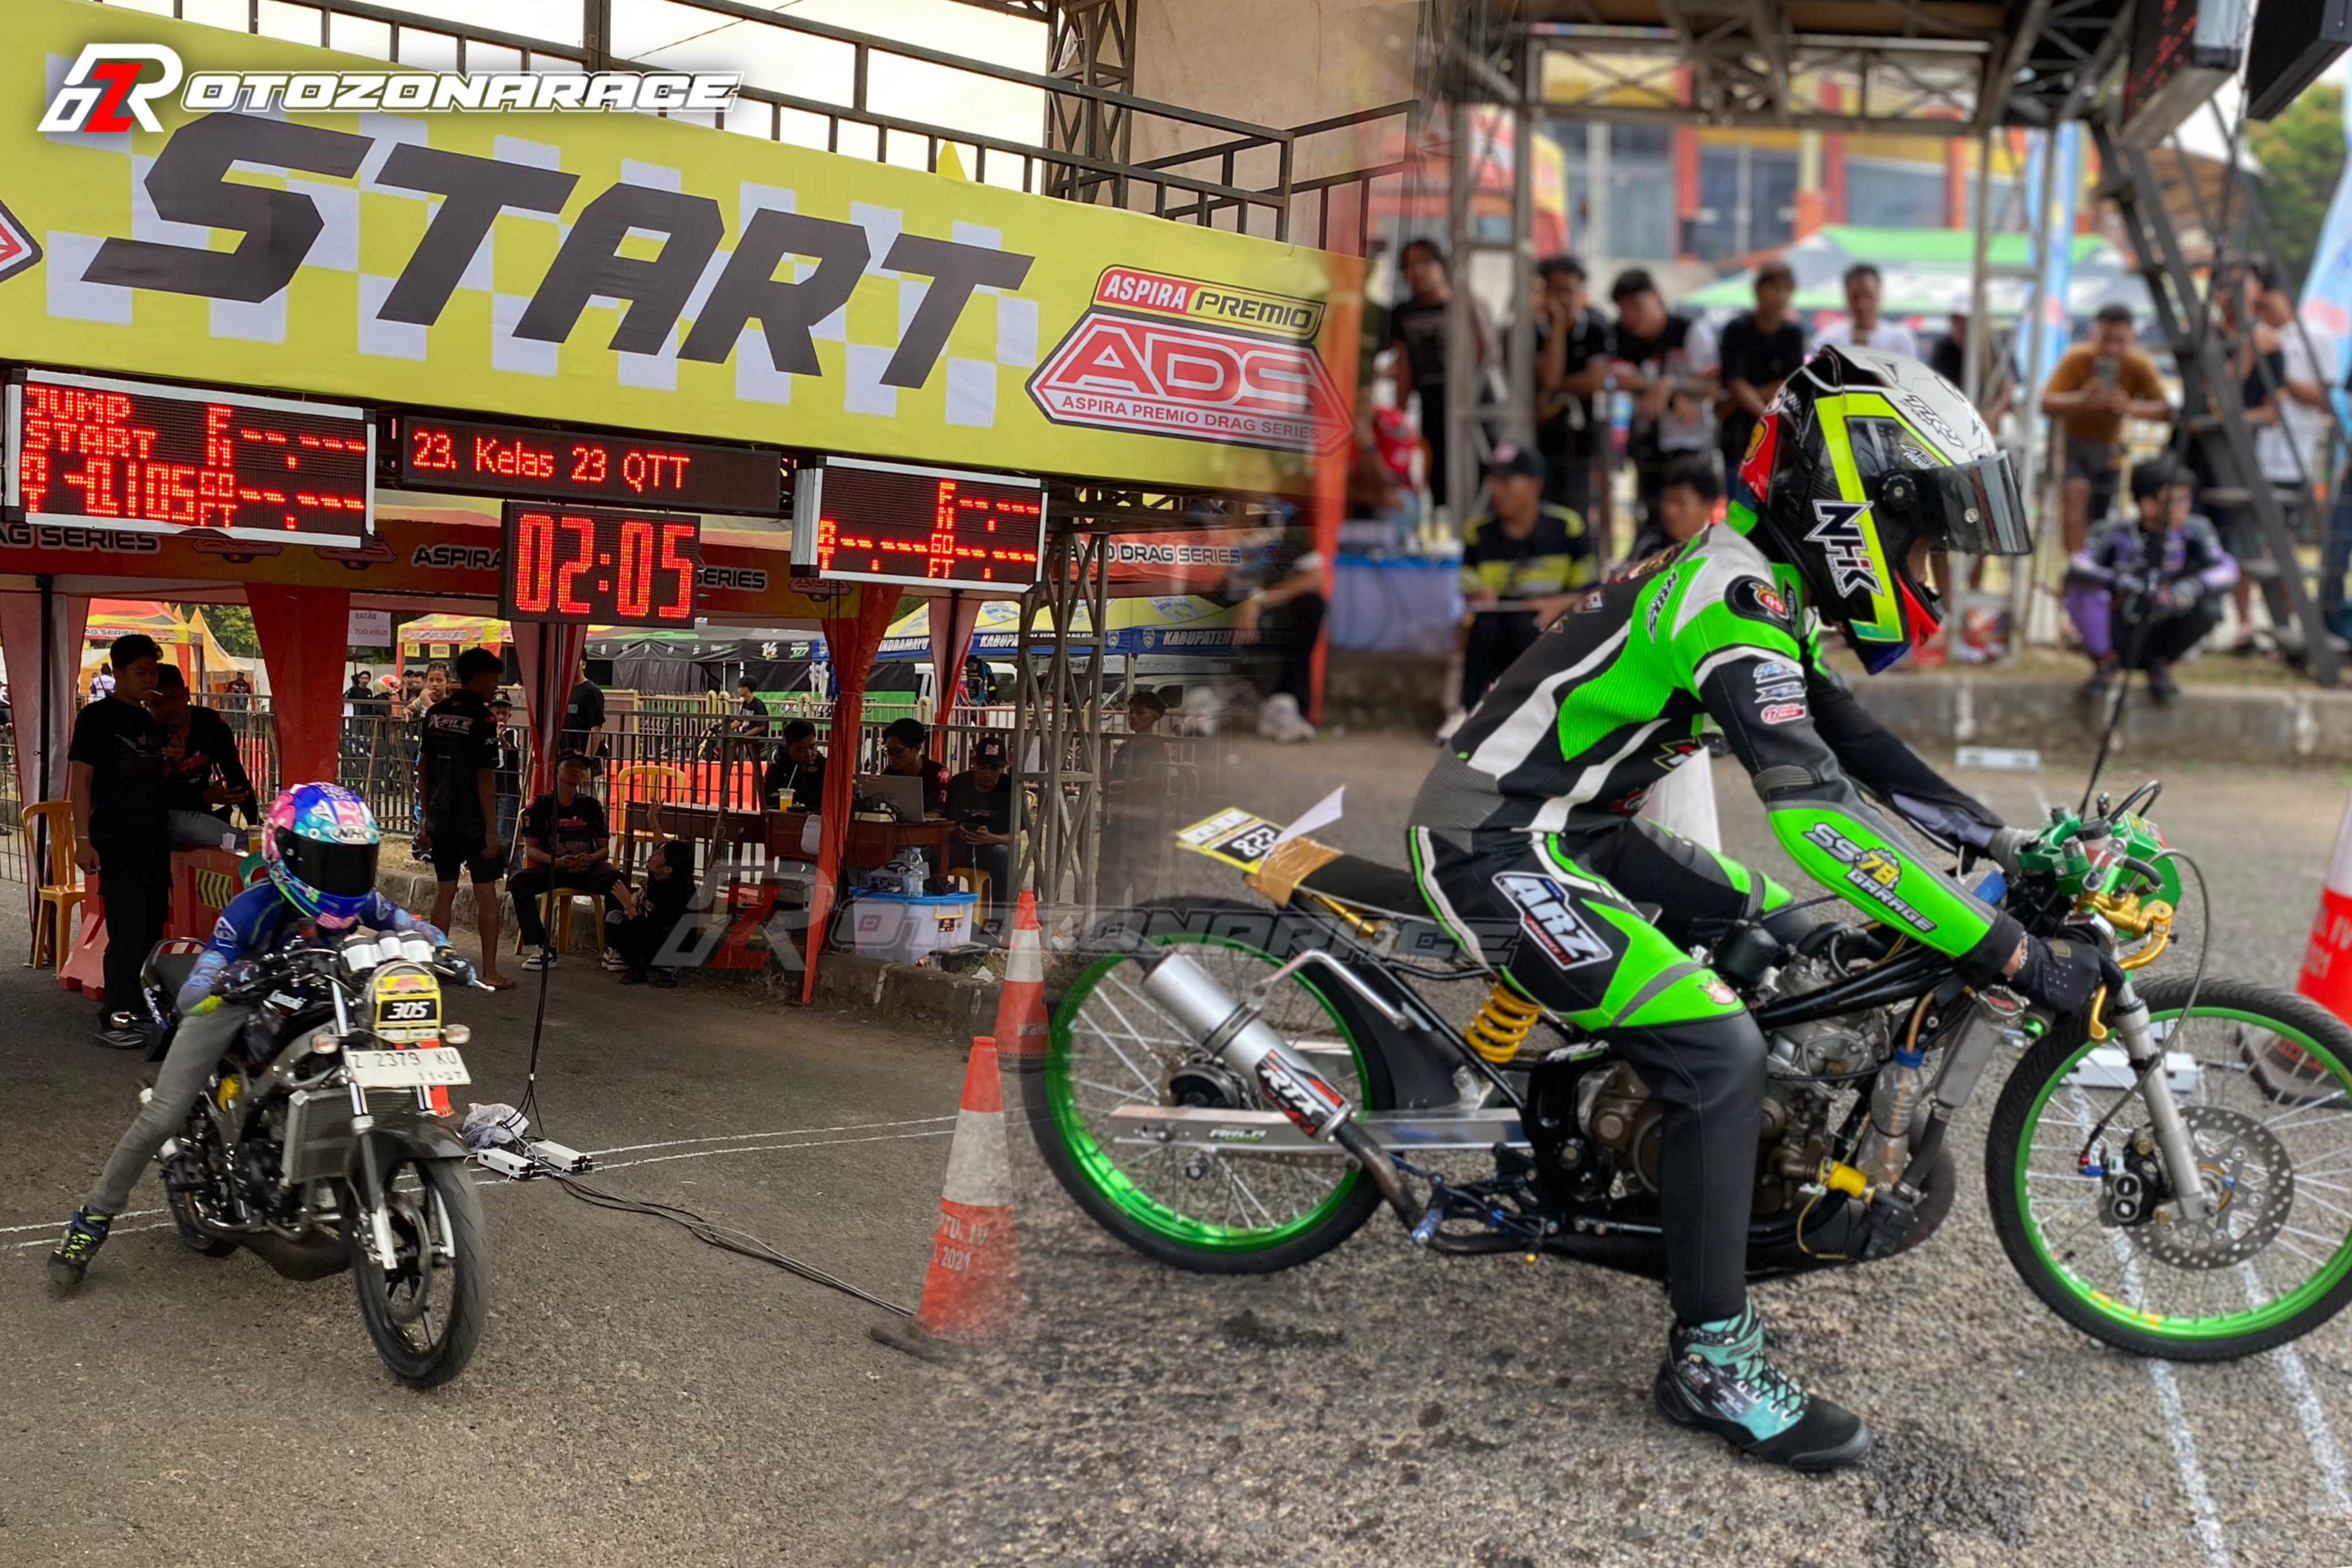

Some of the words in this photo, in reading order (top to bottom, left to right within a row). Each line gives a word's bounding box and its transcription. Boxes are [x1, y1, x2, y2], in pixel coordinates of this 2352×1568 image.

[80, 112, 1035, 389] START
[1104, 274, 1187, 310] ASPIRA
[1195, 291, 1312, 329] PREMIO
[1052, 325, 1338, 419] ADS
[25, 386, 131, 424] JUMP
[1062, 395, 1127, 416] ASPIRA
[1132, 405, 1199, 424] PREMIO
[1205, 414, 1256, 431] DRAG
[1261, 421, 1320, 439] SERIES
[25, 419, 156, 459] START
[412, 431, 457, 470] 23.
[475, 436, 555, 478] Kelas
[571, 446, 607, 482] 23
[623, 452, 691, 493] QTT
[41, 525, 158, 551] SERIES
[1120, 545, 1173, 562] DRAG
[1178, 547, 1241, 564] SERIES
[516, 513, 695, 620] 02:05
[878, 637, 929, 652] INDRAMAYU
[1163, 630, 1232, 646] KABUPATEN
[1500, 877, 1601, 959] ARZ
[1844, 867, 1938, 934] GARAGE
[387, 1001, 430, 1019] 305
[351, 1054, 364, 1068] Z
[374, 1051, 420, 1067] 2379
[433, 1050, 458, 1065] KU
[941, 1245, 971, 1273] 2021
